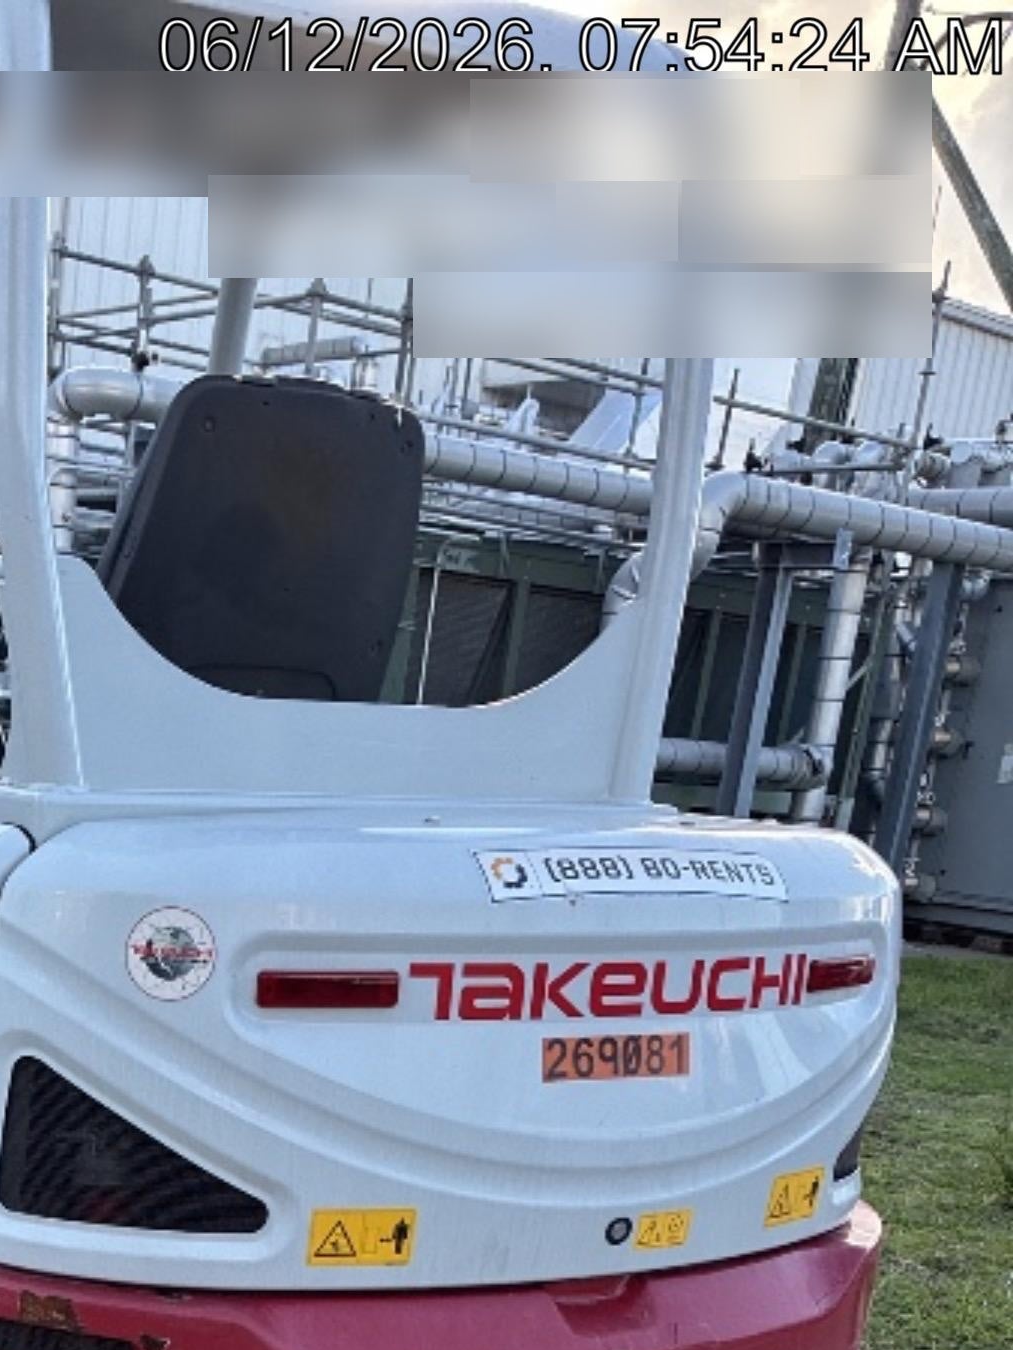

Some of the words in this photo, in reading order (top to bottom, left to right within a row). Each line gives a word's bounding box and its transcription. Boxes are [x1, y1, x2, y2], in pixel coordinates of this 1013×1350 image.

[544, 856, 634, 882] (888)
[408, 953, 807, 1021] TAKEUCHI
[547, 1033, 685, 1081] 269081
